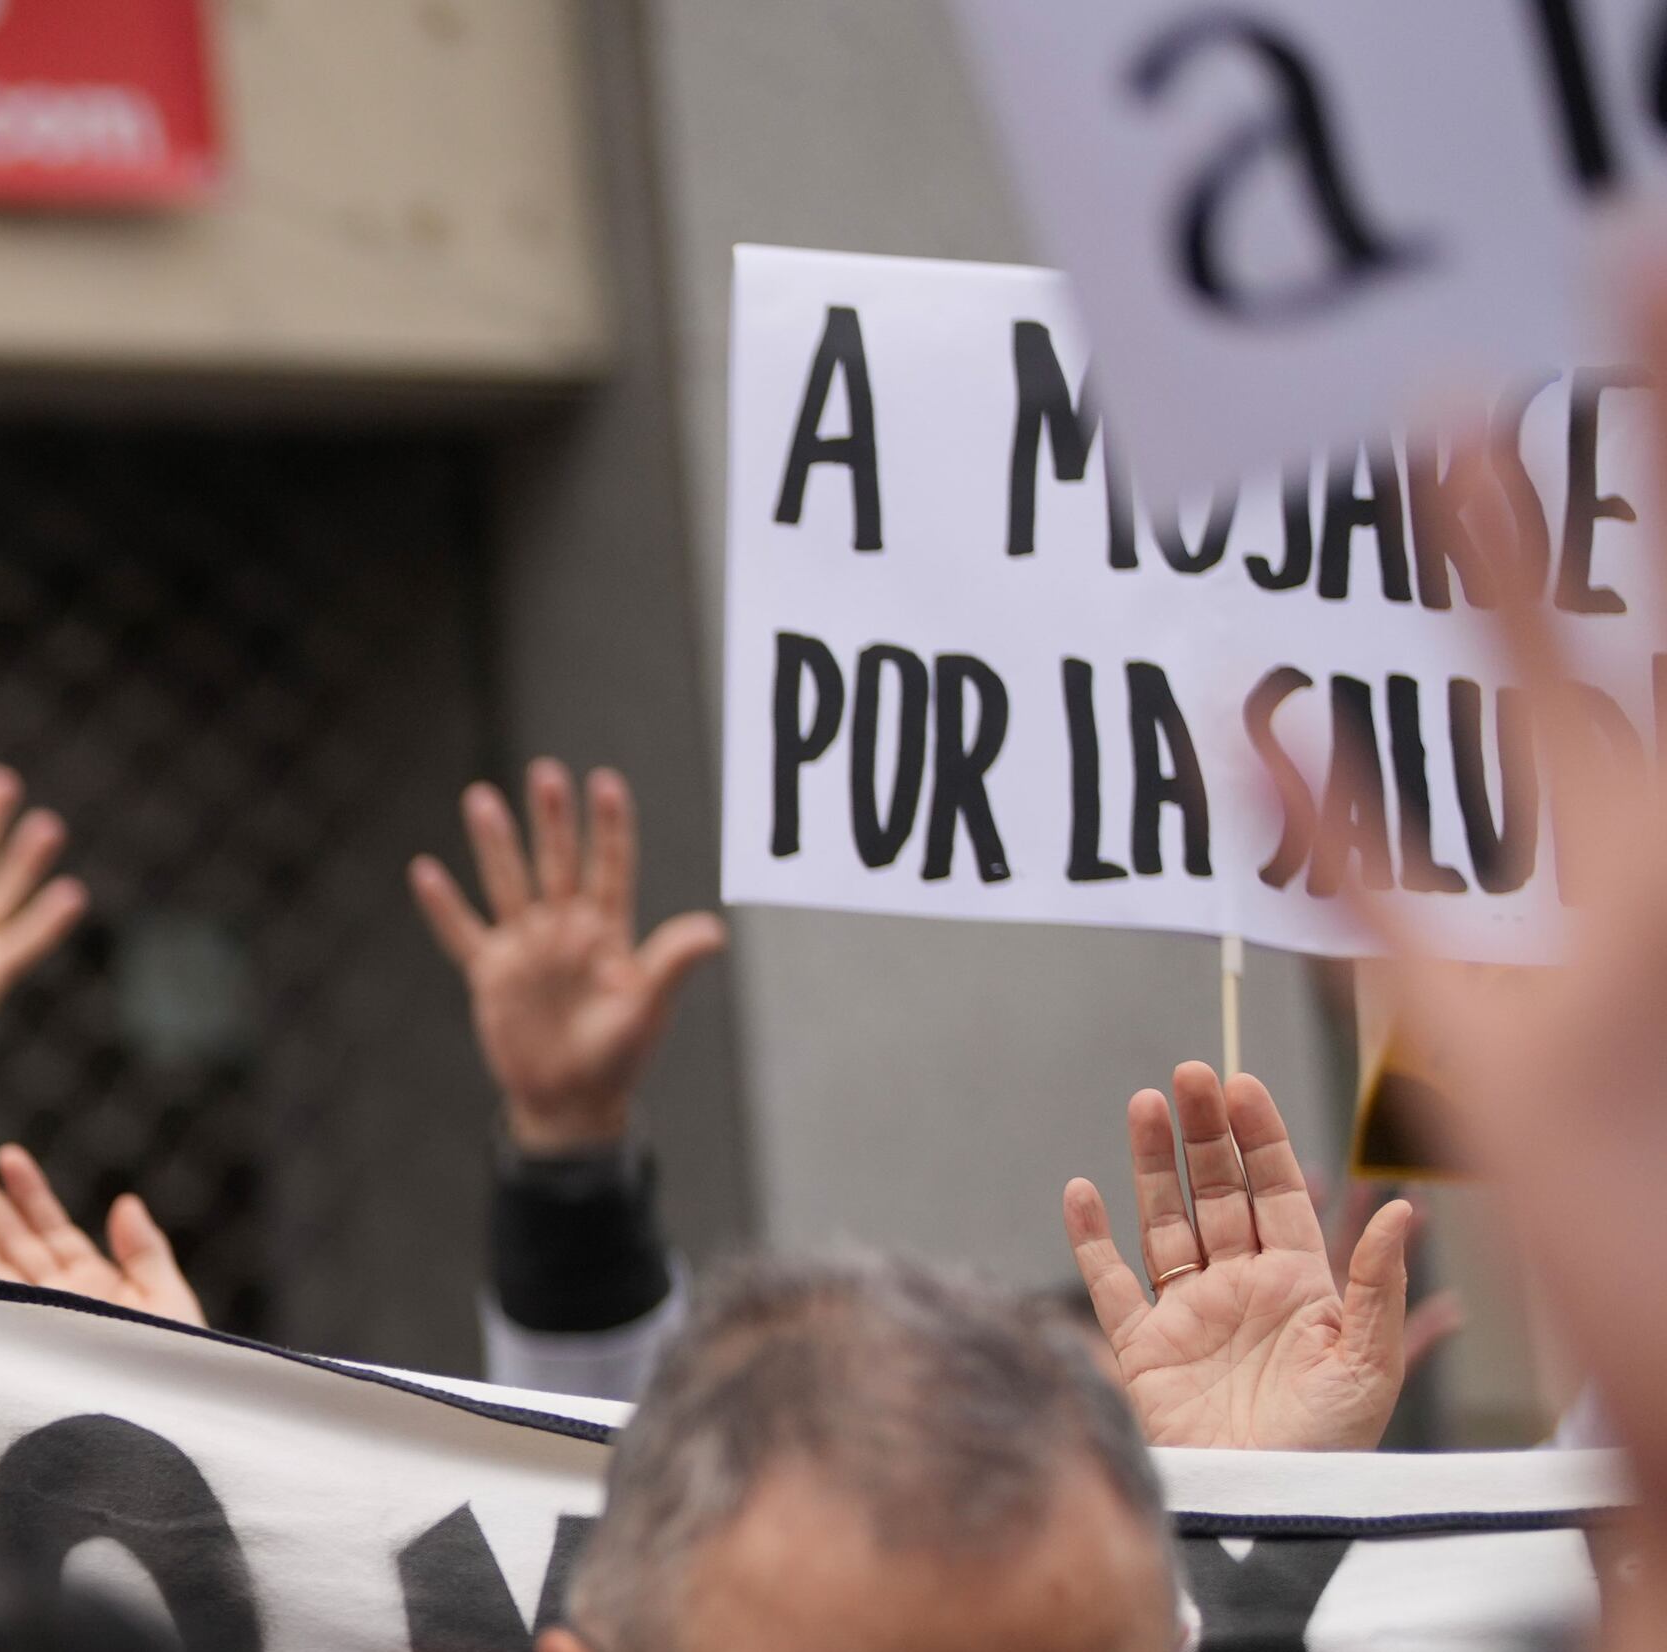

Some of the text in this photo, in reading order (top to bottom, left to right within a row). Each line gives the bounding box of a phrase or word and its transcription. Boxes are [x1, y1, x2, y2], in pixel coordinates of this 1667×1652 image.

[1124, 10, 1432, 324] a
[774, 306, 883, 552] A
[770, 631, 1012, 884] POR
[1062, 657, 1213, 883] LA
